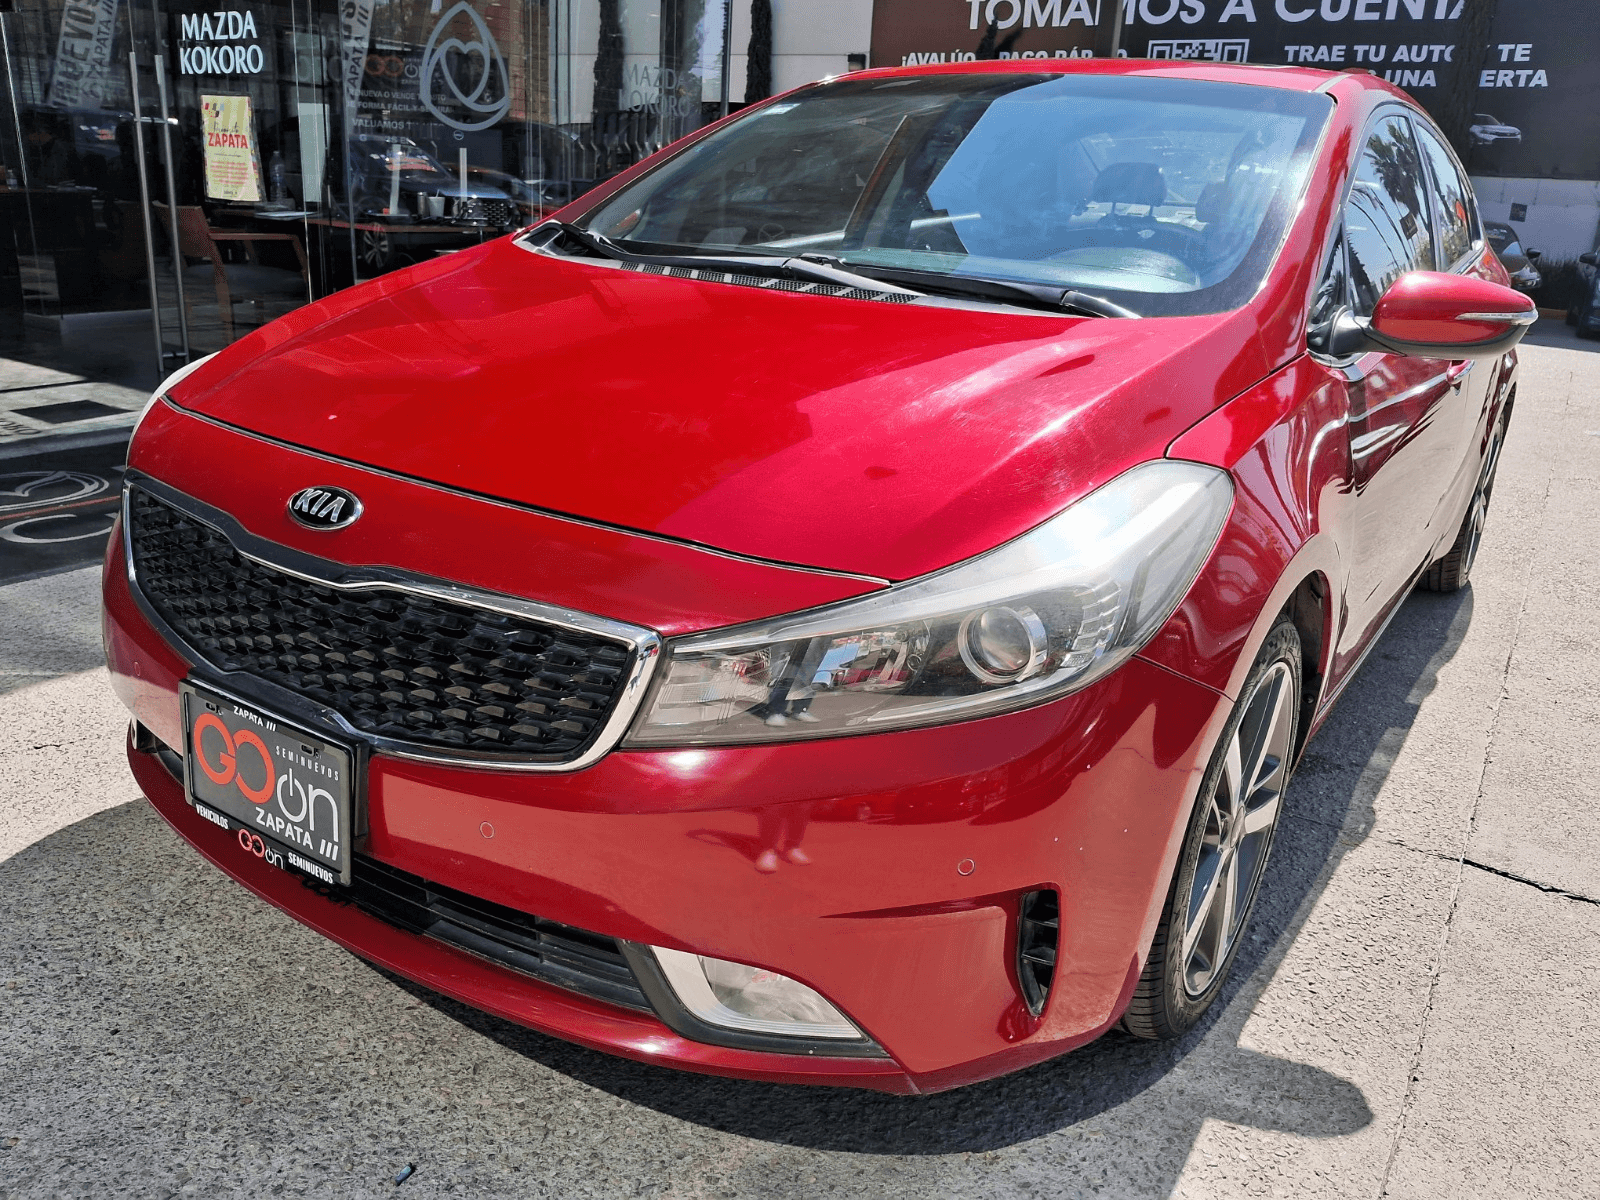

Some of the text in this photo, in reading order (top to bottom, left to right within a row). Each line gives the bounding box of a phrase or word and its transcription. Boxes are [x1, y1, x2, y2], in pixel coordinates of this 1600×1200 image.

[181, 10, 258, 40] MAZDA
[1218, 0, 1257, 23] A
[180, 44, 264, 75] KOKORO
[1284, 45, 1347, 62] TRAE
[1353, 44, 1387, 62] TU
[1498, 43, 1533, 62] TE
[1385, 69, 1549, 87] UNA ERTA
[207, 132, 248, 149] ZAPATA
[293, 488, 347, 523] KIA
[233, 705, 264, 727] ZAPATA
[275, 745, 339, 781] SEMINUEVOS
[255, 806, 339, 861] ZAPATA III
[287, 851, 334, 885] SEMINUEVOS
